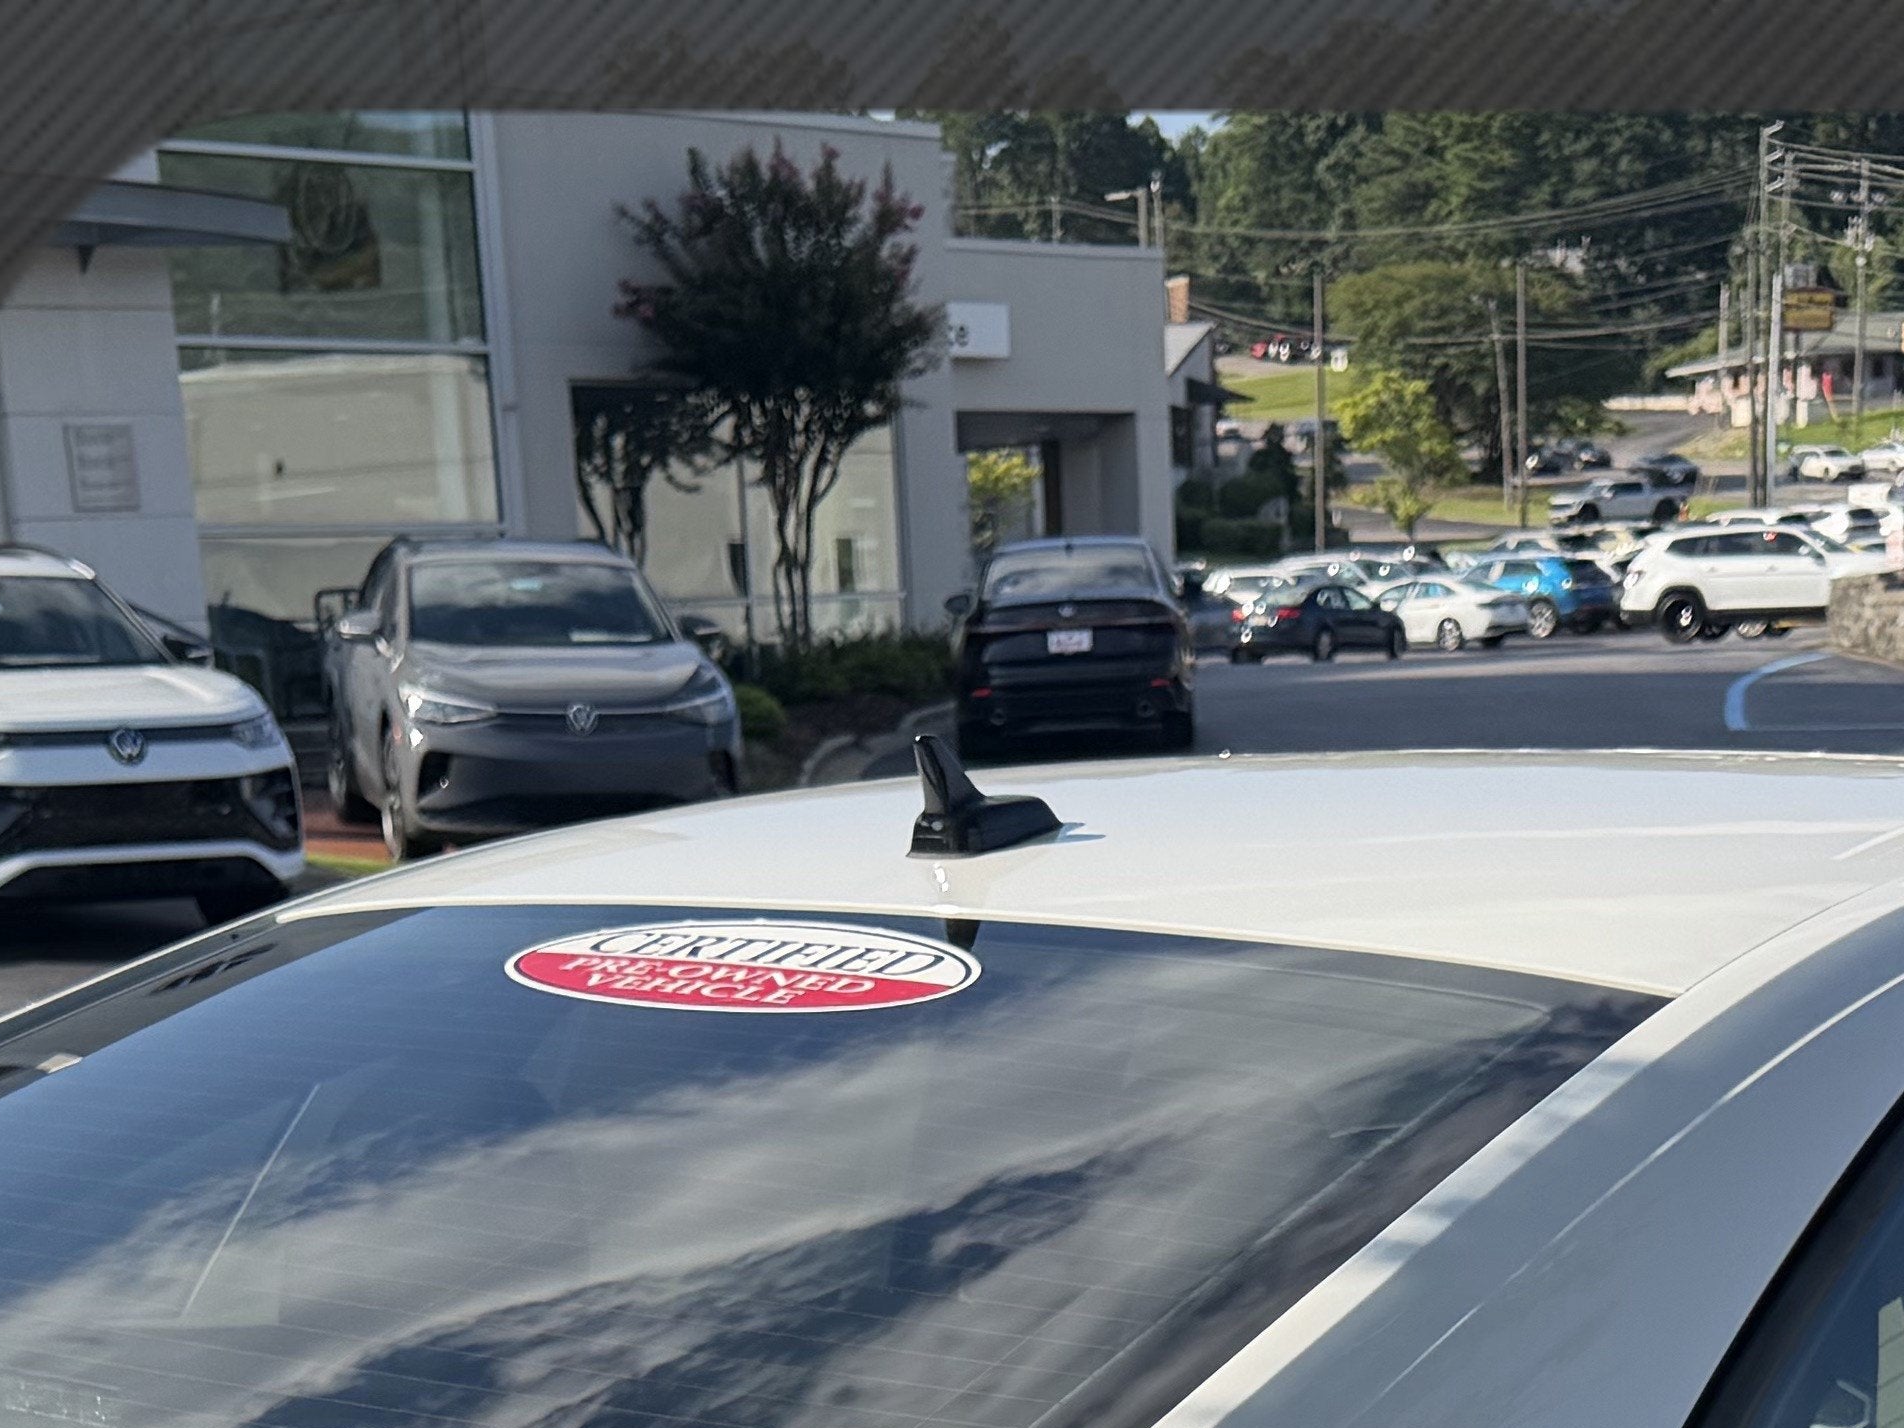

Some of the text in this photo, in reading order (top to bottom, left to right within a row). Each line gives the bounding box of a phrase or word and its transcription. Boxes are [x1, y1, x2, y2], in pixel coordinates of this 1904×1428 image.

[590, 930, 946, 977] CERTIFIED
[560, 954, 877, 995] PRE-OWNED
[583, 972, 811, 1006] VEHICLE
